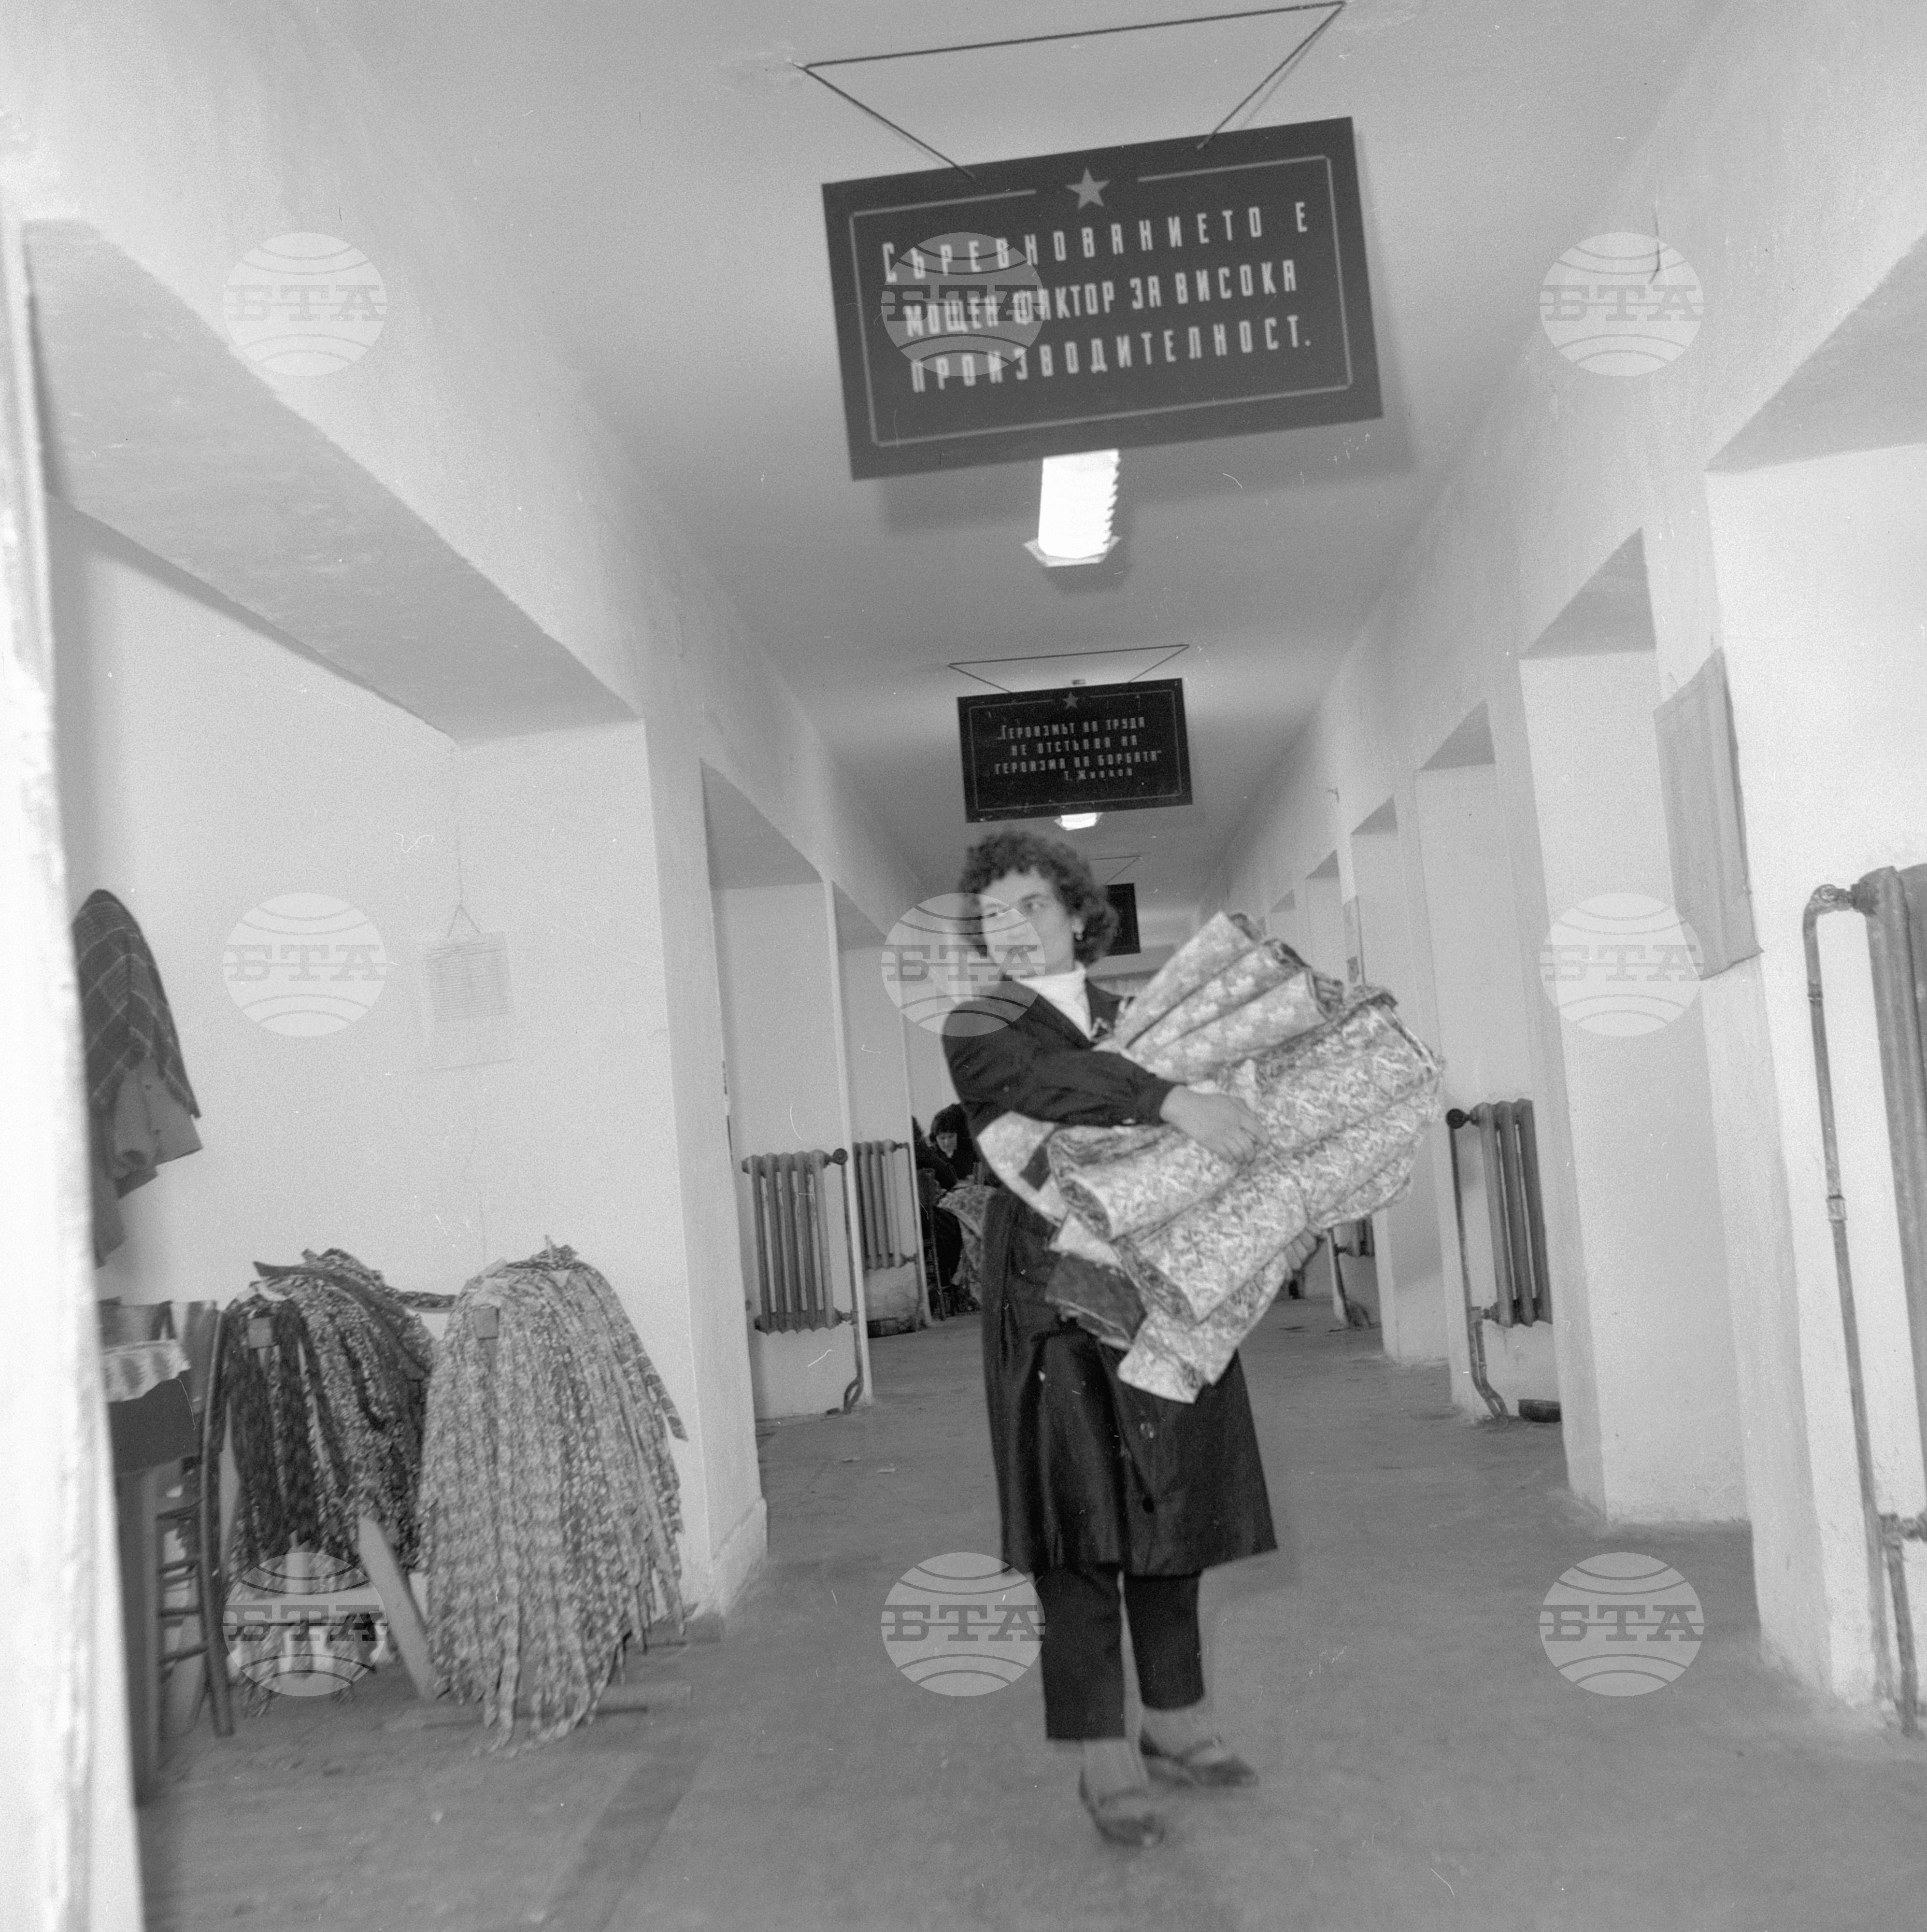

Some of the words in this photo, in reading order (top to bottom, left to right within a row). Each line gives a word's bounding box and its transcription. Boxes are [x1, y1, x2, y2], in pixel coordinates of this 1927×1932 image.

[882, 206, 1262, 283] СЪРЕВНОВАНИЕТО
[1295, 201, 1308, 233] Е
[904, 295, 999, 337] МОЩЕН
[1013, 281, 1115, 325] ФАКТОР
[1129, 275, 1162, 310] ЗА
[1174, 259, 1297, 305] ВИСОКА
[911, 314, 1312, 393] ПРОИЗВОДИТЕЛНОСТ.
